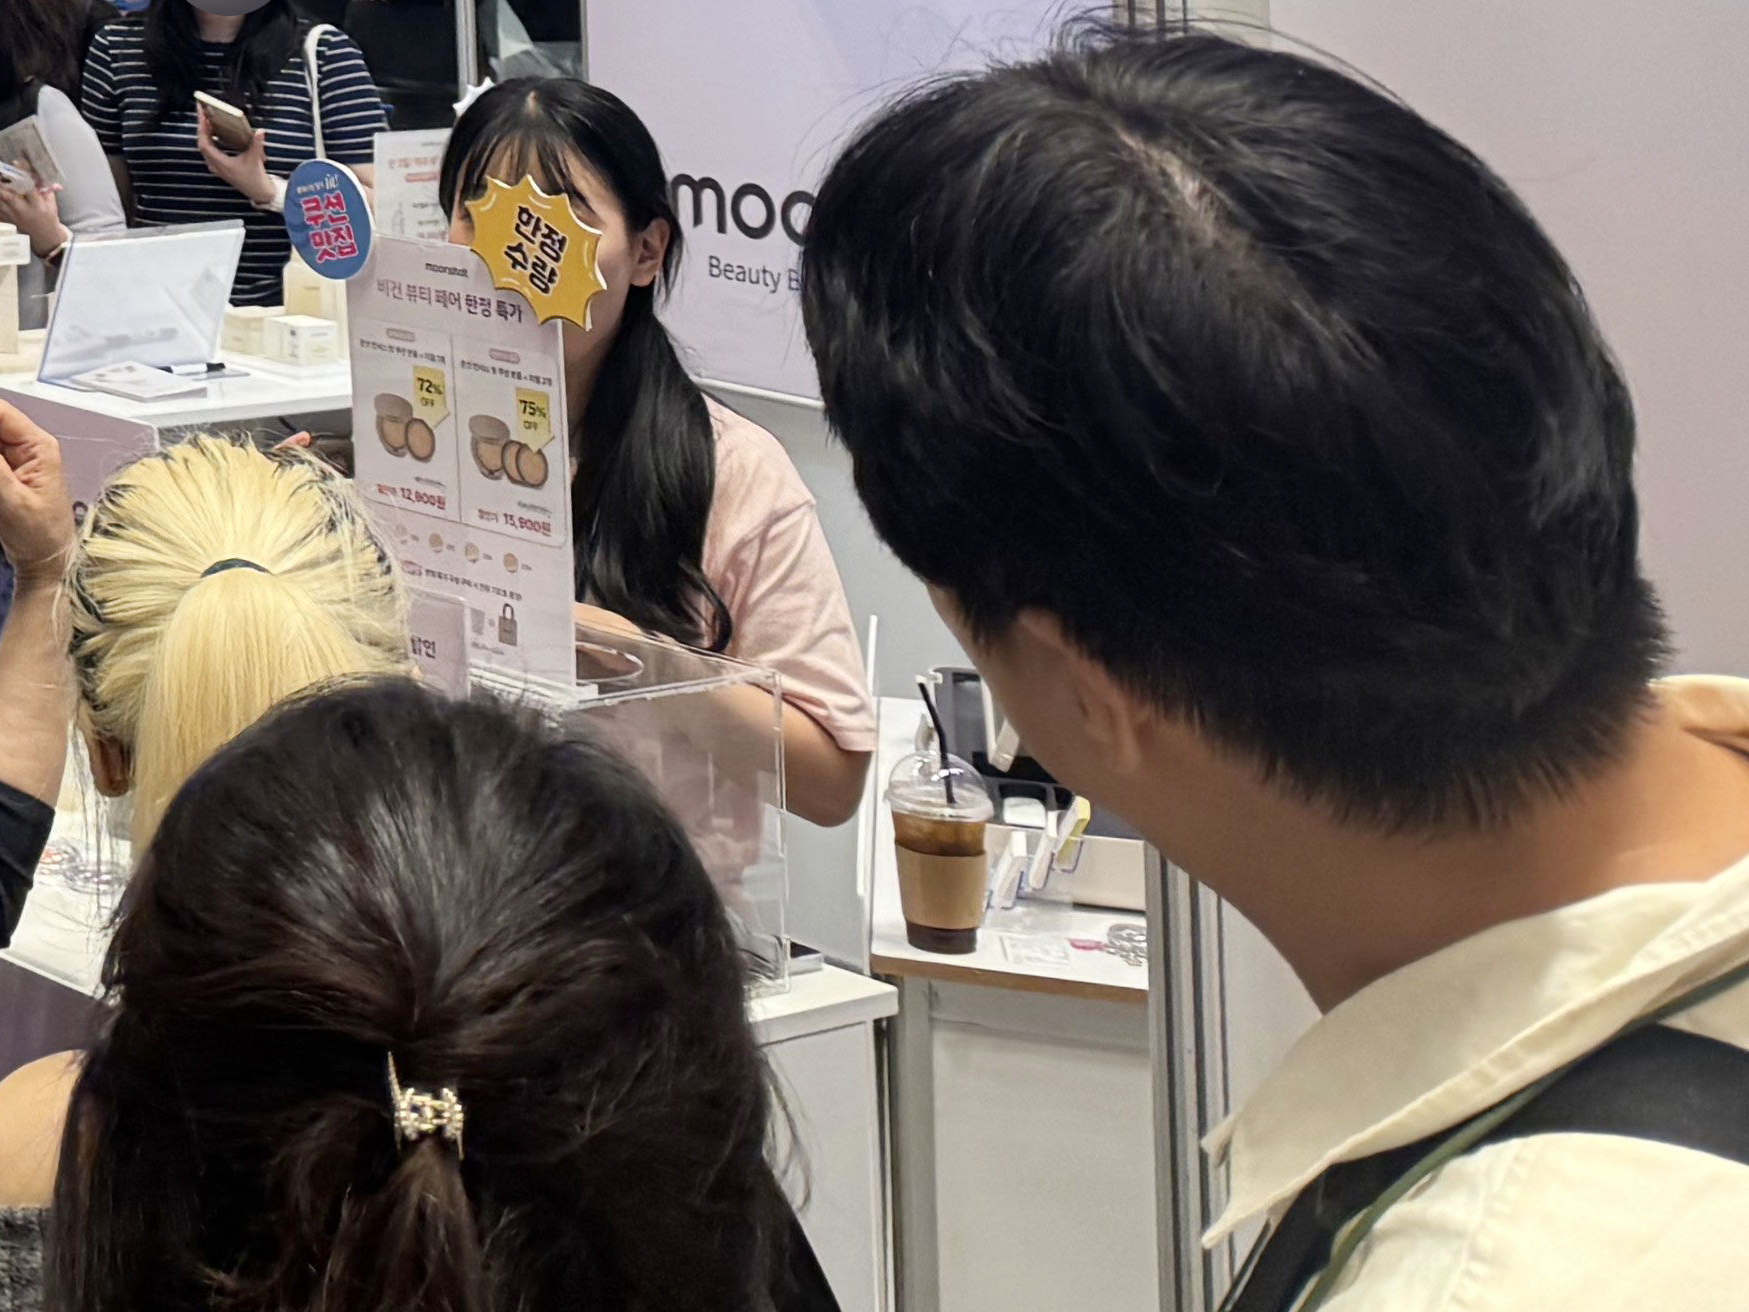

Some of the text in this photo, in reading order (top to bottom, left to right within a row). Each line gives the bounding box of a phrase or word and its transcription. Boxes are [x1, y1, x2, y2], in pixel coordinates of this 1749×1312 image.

[302, 189, 349, 227] 쿠션
[309, 224, 359, 264] 맛집
[514, 205, 567, 263] 한정
[504, 242, 558, 295] 수량
[708, 255, 780, 294] Beauty
[376, 279, 523, 324] 비건 뷰티 페어 한정 특가
[417, 377, 444, 395] 72%
[519, 398, 547, 419] 75%
